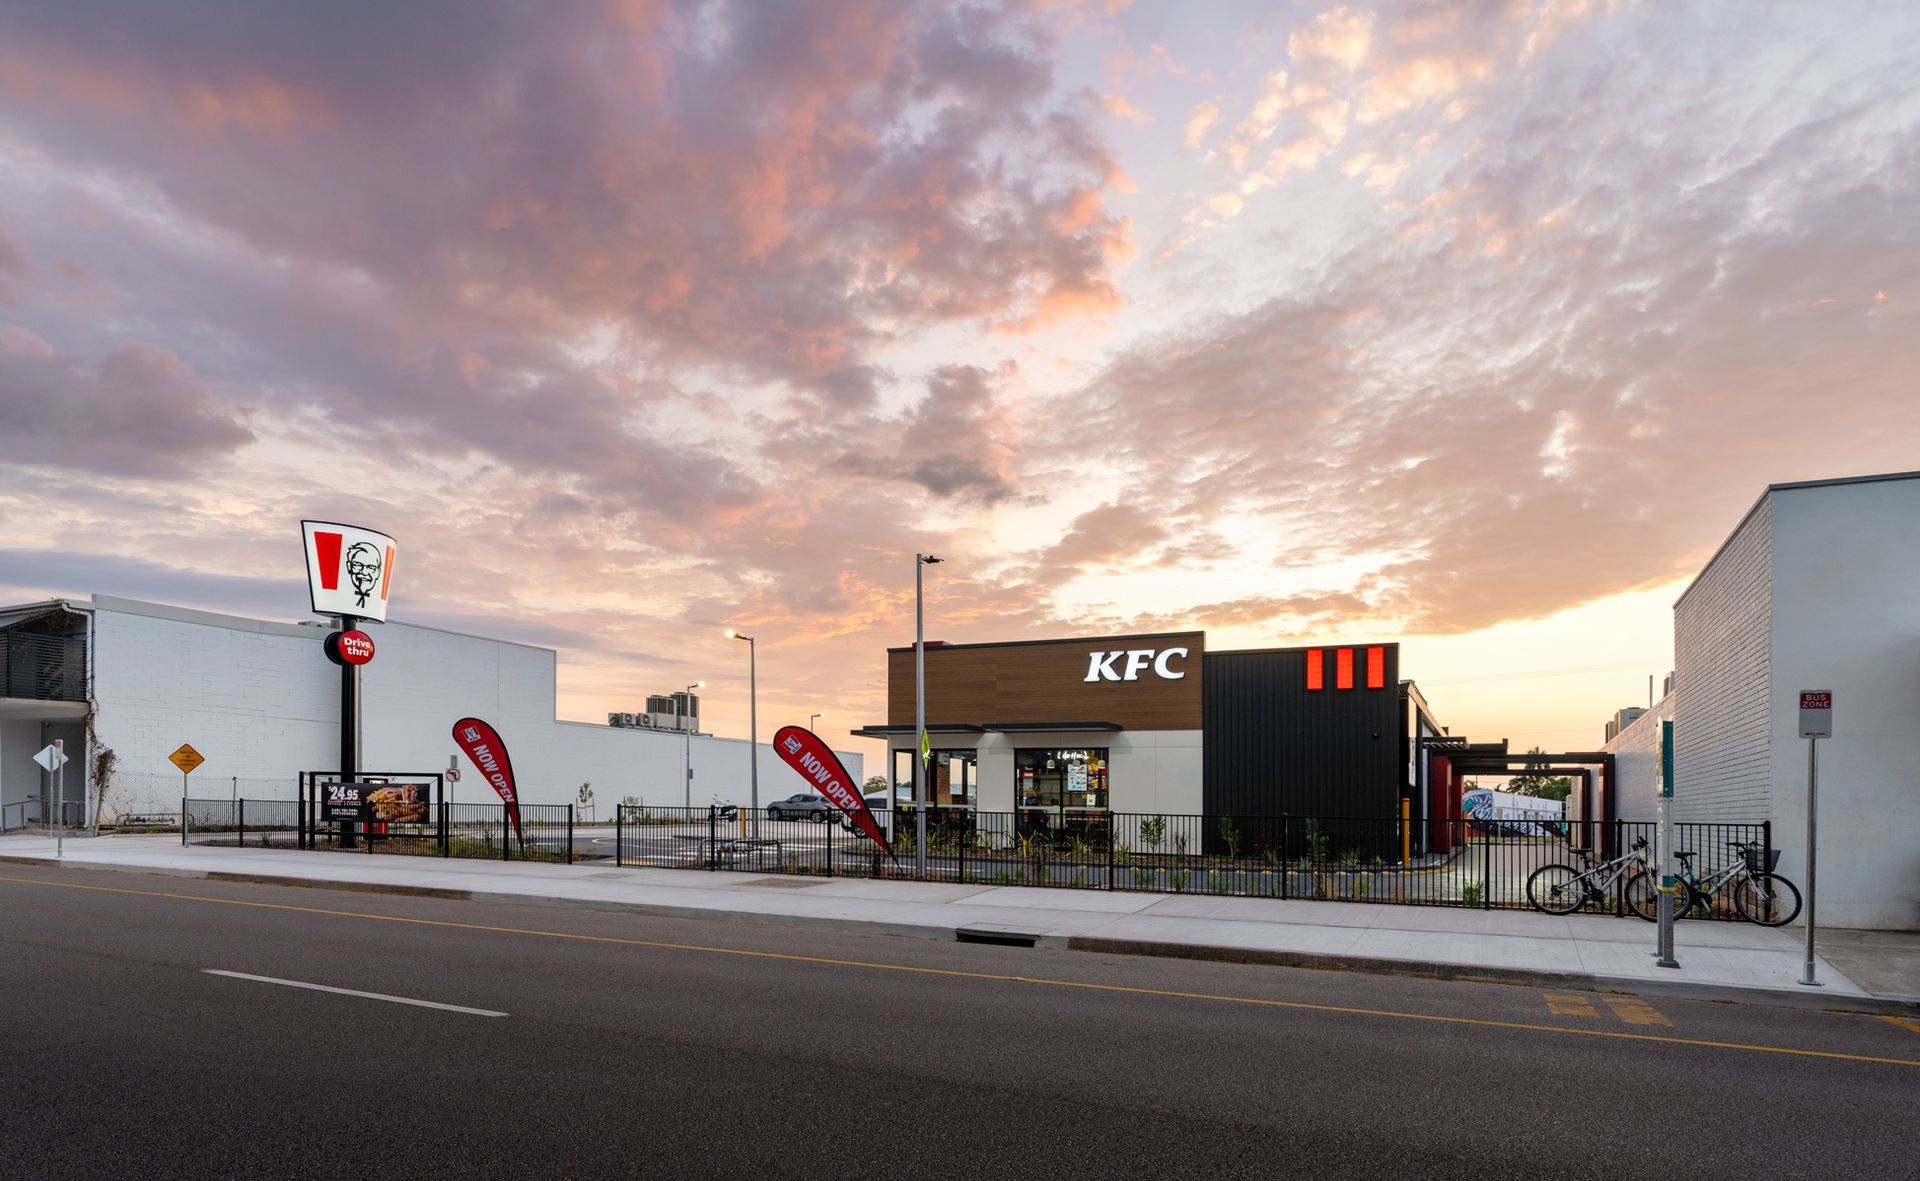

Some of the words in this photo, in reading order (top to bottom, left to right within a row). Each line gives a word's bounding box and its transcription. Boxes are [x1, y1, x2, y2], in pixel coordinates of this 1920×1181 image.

[343, 637, 371, 649] Drive
[347, 646, 369, 657] thru
[1083, 647, 1188, 682] KFC
[1802, 700, 1830, 708] ZONE
[473, 744, 499, 772] NOW
[491, 773, 515, 803] OPEN
[799, 751, 832, 784] NOW
[826, 780, 861, 811] OPEN
[328, 785, 359, 801] $24.95
